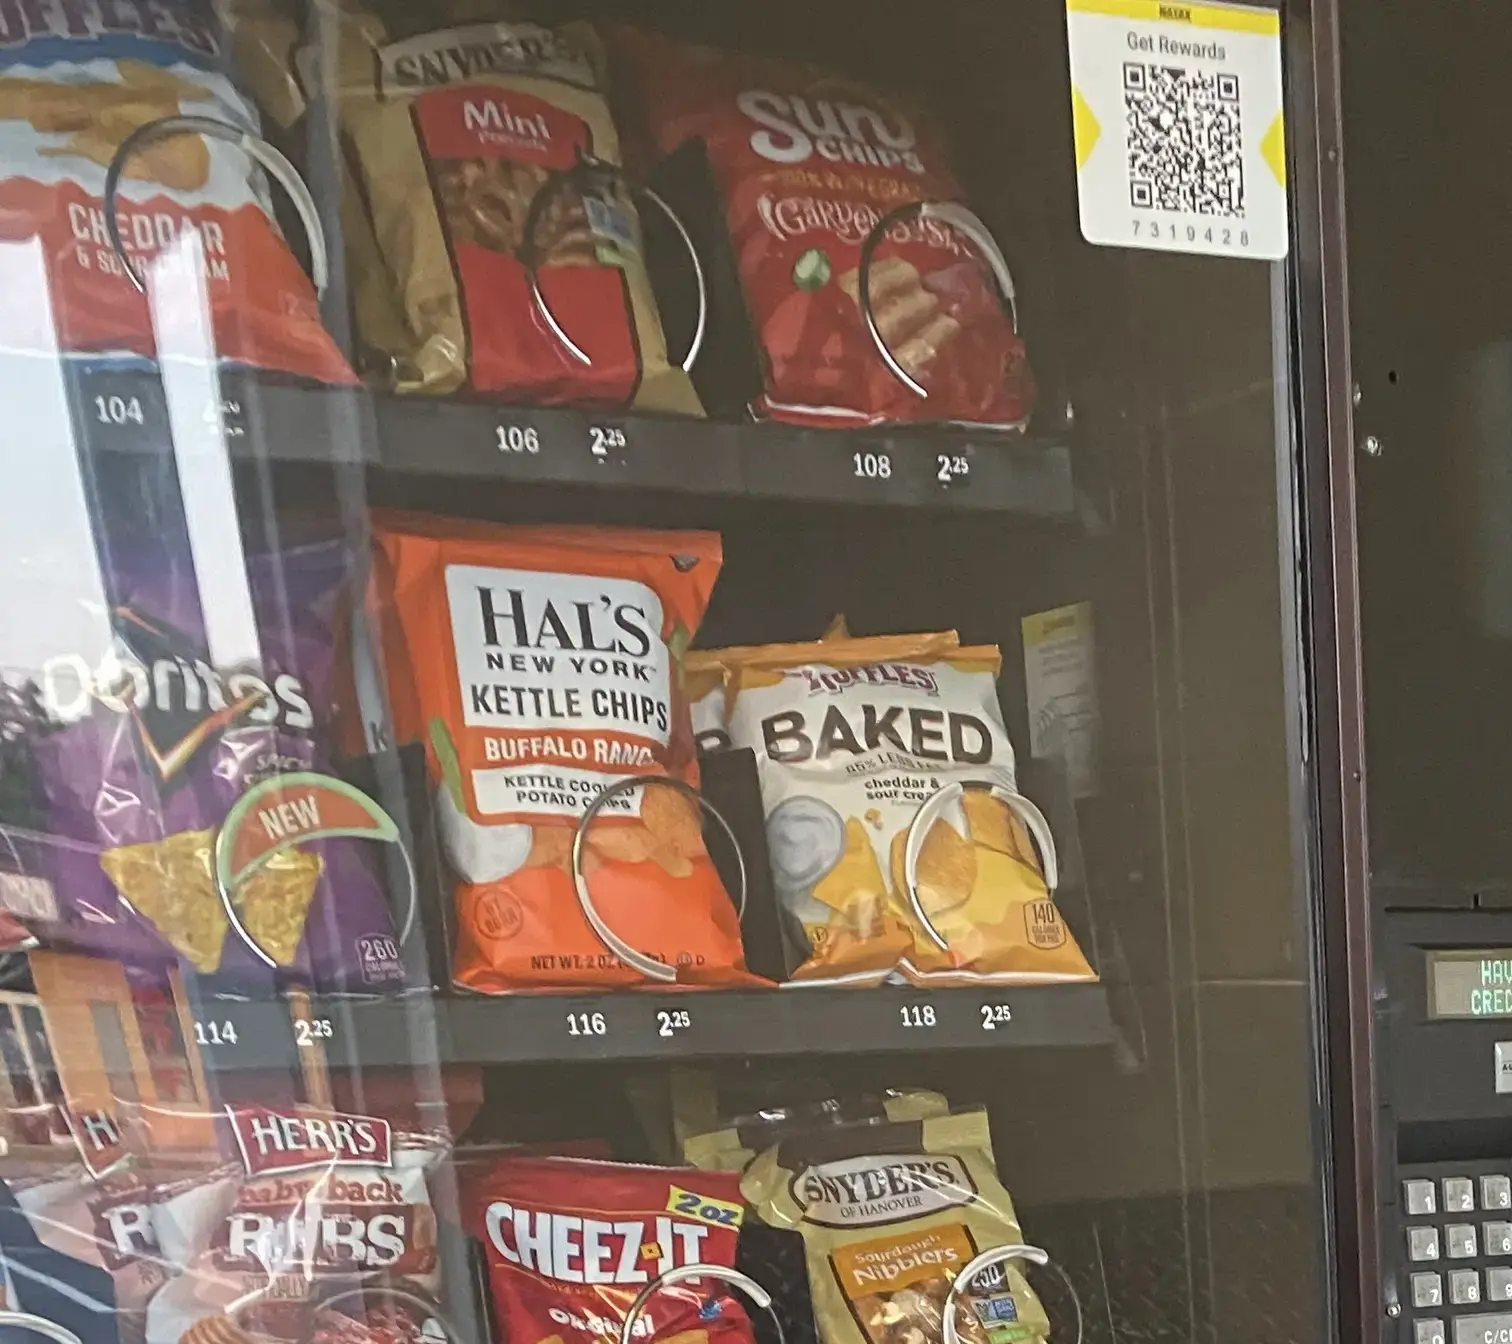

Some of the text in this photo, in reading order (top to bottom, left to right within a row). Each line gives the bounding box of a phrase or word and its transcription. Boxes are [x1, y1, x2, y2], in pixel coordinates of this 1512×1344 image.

[1127, 31, 1226, 61] Get Rewards
[463, 99, 552, 141] Mini
[94, 395, 144, 425] 104
[496, 426, 540, 454] 106
[852, 452, 893, 479] 108
[475, 584, 651, 657] HAL'S
[486, 651, 651, 683] NEW YORK
[470, 682, 669, 733] KETTLE CHIPS
[761, 703, 993, 765] BAKED
[484, 736, 588, 762] BUFFALO
[504, 774, 565, 791] KETTLE
[864, 775, 926, 790] cheddar
[866, 789, 899, 801] sour
[516, 790, 577, 808] POTATO
[258, 794, 321, 841] NEW
[1031, 902, 1056, 925] 140
[361, 938, 399, 962] 260
[566, 1010, 692, 1037] 116 2.25
[900, 1004, 1012, 1029] 118 2.25
[196, 1018, 334, 1047] 114 2.25
[251, 1117, 378, 1156] HERR'S
[327, 1173, 404, 1204] back
[804, 1160, 959, 1206] SNYDER'S
[840, 1195, 923, 1219] OF HANOVER
[1424, 1196, 1433, 1209] 1
[1461, 1193, 1472, 1208] 2
[1499, 1192, 1509, 1207] 3
[1425, 1242, 1437, 1258] 4
[1464, 1239, 1474, 1254] 5
[1501, 1237, 1511, 1252] 6
[852, 1247, 959, 1287] Nibblers
[1429, 1289, 1439, 1303] 7
[1467, 1285, 1477, 1300] 8
